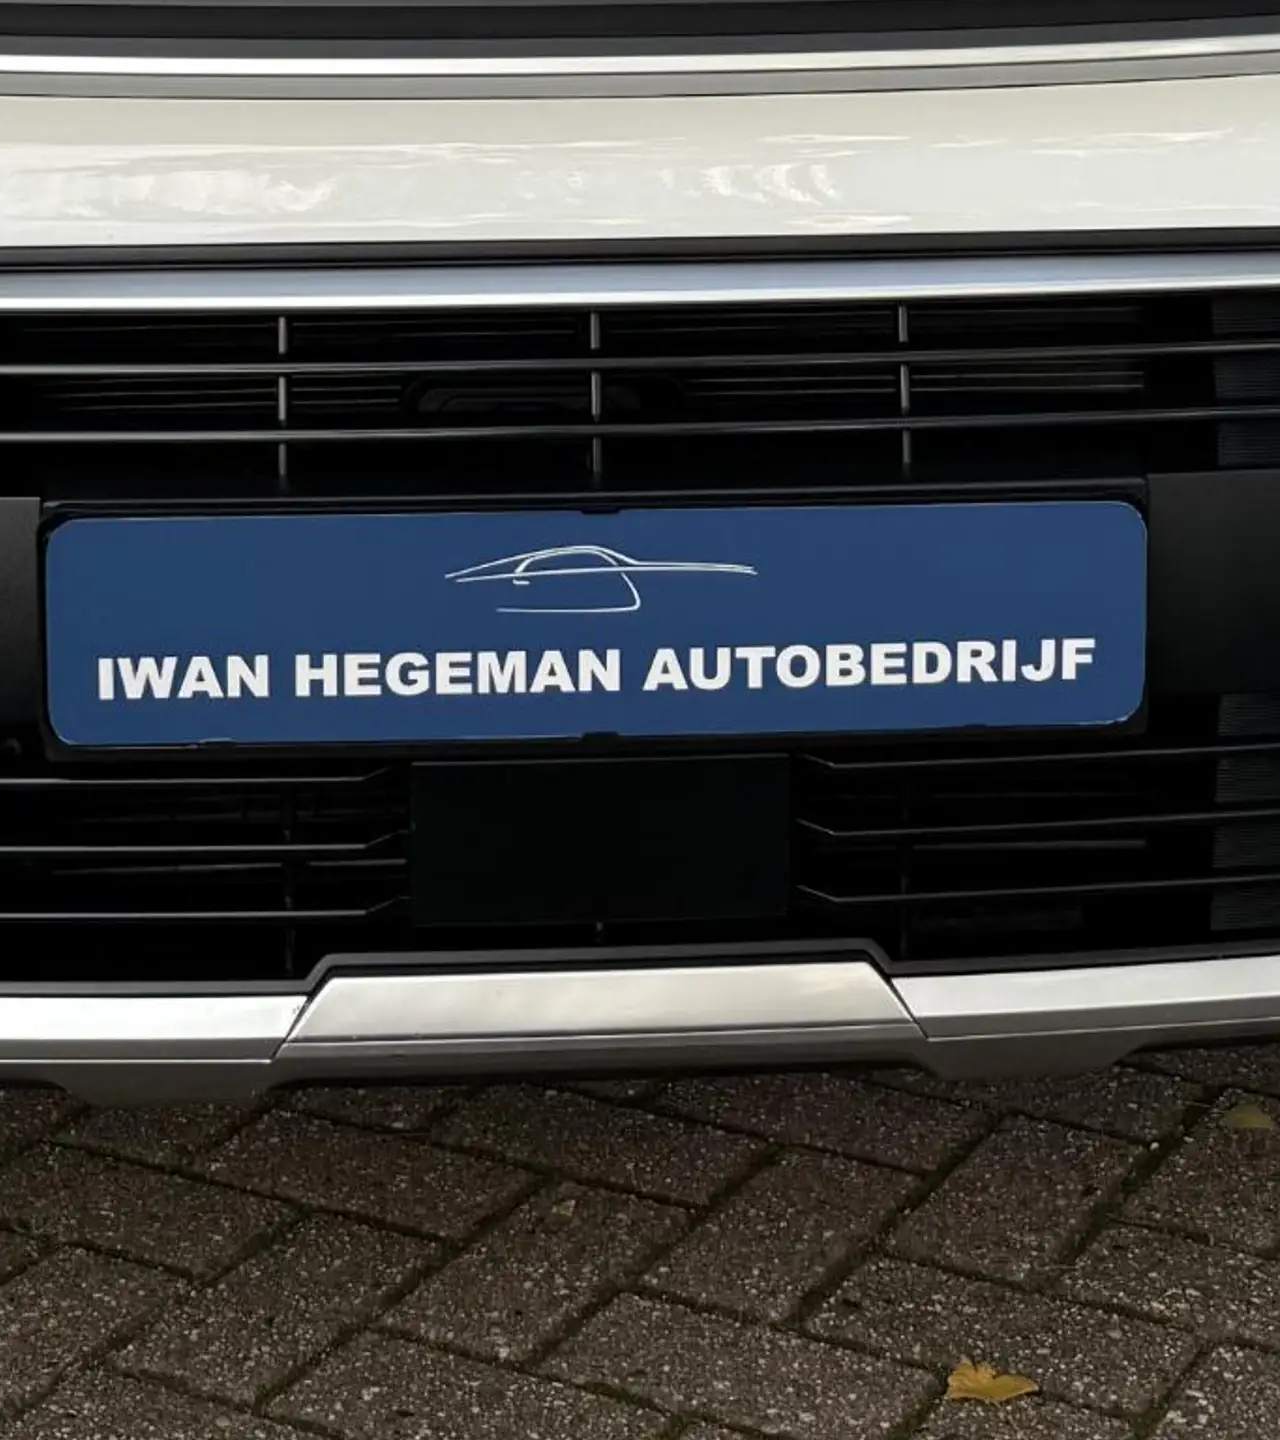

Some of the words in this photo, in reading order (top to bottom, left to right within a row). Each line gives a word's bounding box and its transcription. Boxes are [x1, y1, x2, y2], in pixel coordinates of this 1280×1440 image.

[98, 654, 269, 700] IWAN
[294, 648, 621, 697] HEGEMAN
[641, 637, 1096, 691] AUTOBEDRIJF
